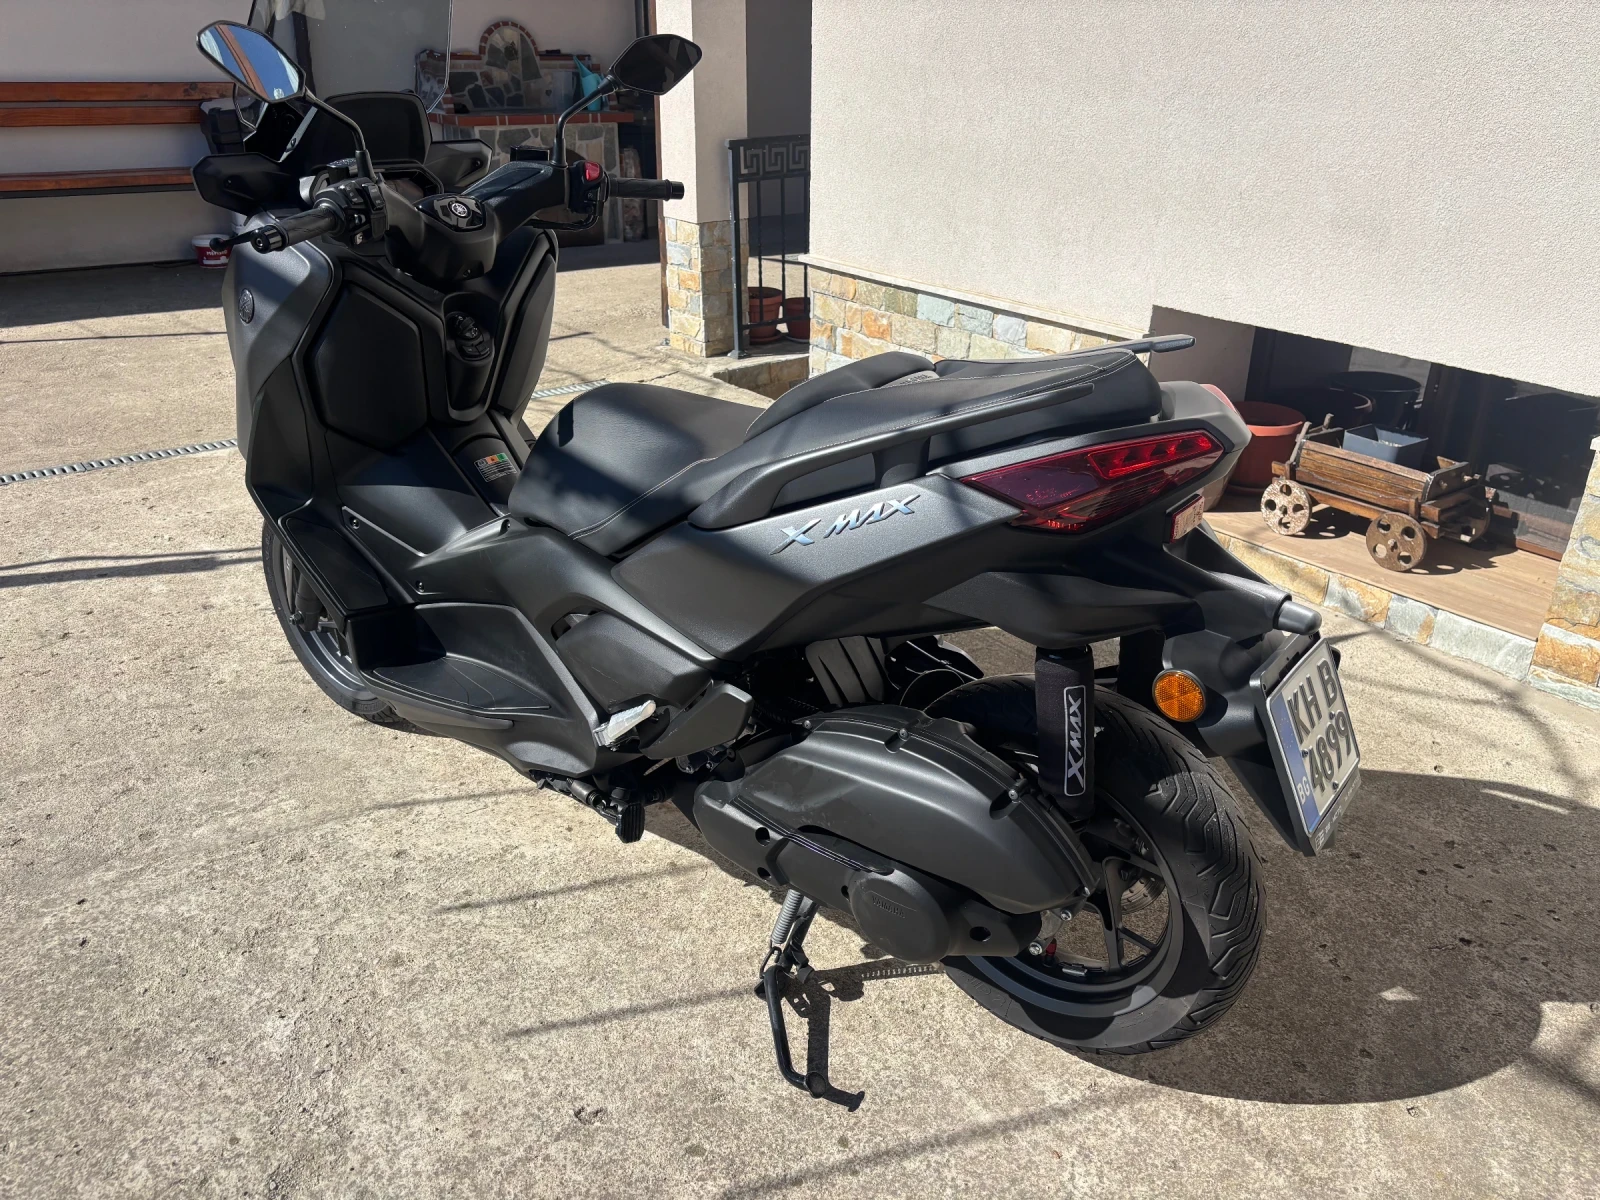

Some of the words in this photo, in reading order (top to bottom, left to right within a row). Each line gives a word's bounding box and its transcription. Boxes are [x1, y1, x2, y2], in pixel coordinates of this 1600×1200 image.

[769, 519, 822, 555] X
[823, 494, 921, 539] MAX
[1287, 673, 1323, 745] KH
[1316, 658, 1338, 709] B
[1307, 709, 1352, 793] 4899
[1297, 776, 1311, 805] BG
